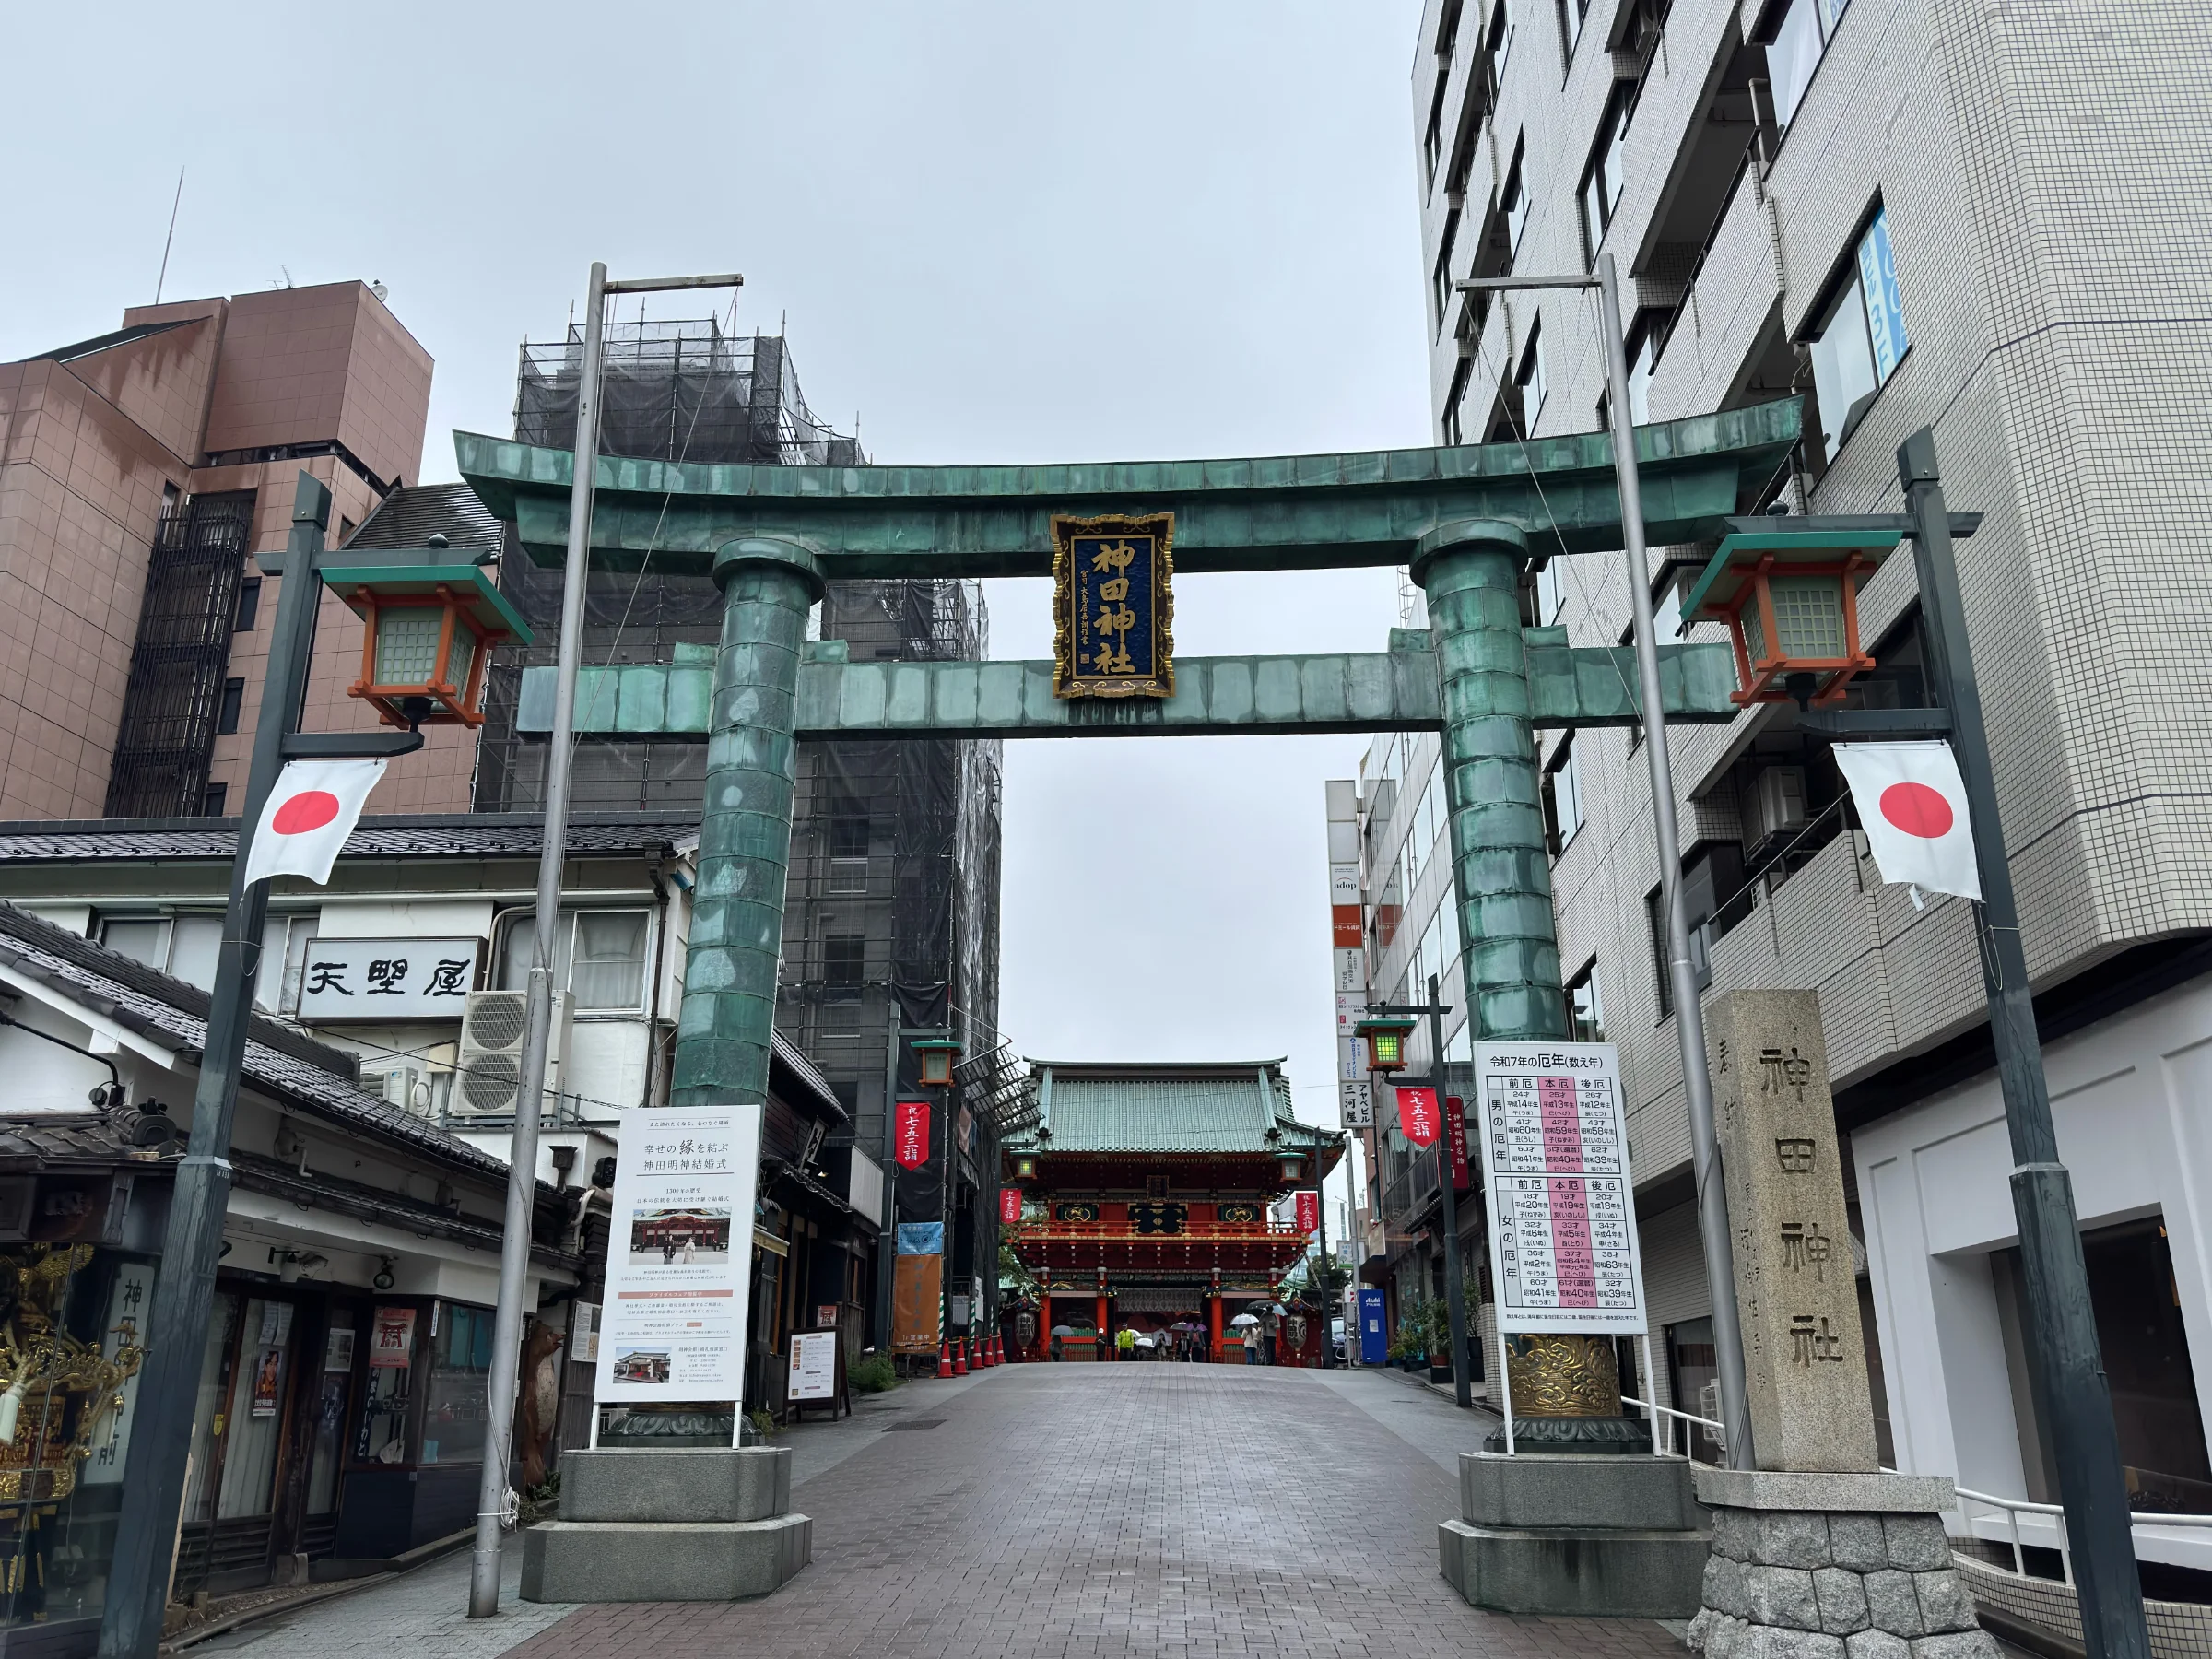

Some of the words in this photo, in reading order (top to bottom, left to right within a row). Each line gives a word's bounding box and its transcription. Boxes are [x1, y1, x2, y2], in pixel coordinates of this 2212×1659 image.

[1091, 540, 1136, 674] 神田神社
[1335, 882, 1356, 890] adop
[1490, 1053, 1603, 1068] 令和7年の厄年(数え年)
[1509, 1079, 1532, 1088] 前厄
[1545, 1079, 1568, 1088] 本厄
[1581, 1079, 1605, 1089] 後厄
[1344, 1085, 1357, 1122] 三河屋
[1359, 1085, 1370, 1123] アヤベビル
[1410, 1097, 1430, 1137] 七五三詣
[1492, 1100, 1506, 1160] 男の厄年
[645, 1140, 728, 1155] 幸せの縁を結ぶ
[904, 1117, 919, 1161] 七五三詣
[1453, 1114, 1464, 1165] 神田明神名物
[644, 1159, 727, 1171] 神田明神結婚式
[1518, 1180, 1541, 1190] 前厄
[1555, 1180, 1579, 1190] 本厄
[1591, 1180, 1616, 1190] 後厄
[1759, 1047, 1843, 1369] 神田神社
[1501, 1215, 1517, 1279] 女の厄年
[98, 1279, 142, 1466] 神田前
